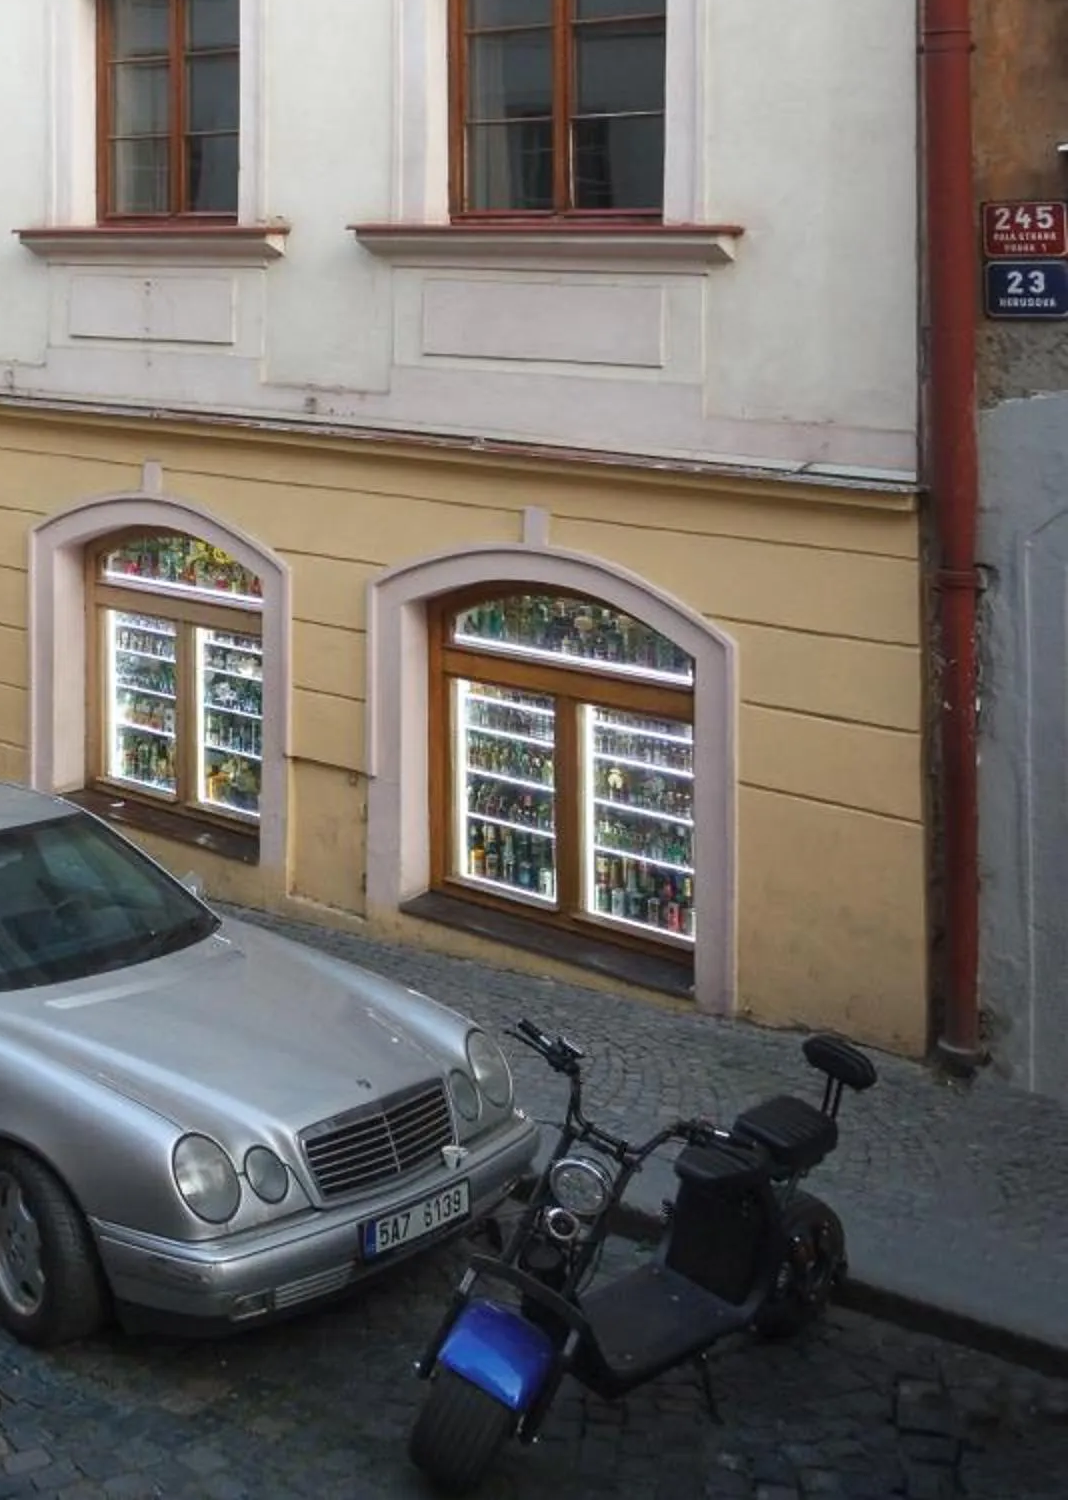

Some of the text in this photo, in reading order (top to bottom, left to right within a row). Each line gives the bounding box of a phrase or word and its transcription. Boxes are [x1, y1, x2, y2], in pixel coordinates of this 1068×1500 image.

[994, 205, 1054, 230] 245
[1006, 269, 1046, 295] 23
[378, 1211, 412, 1246] 5A7
